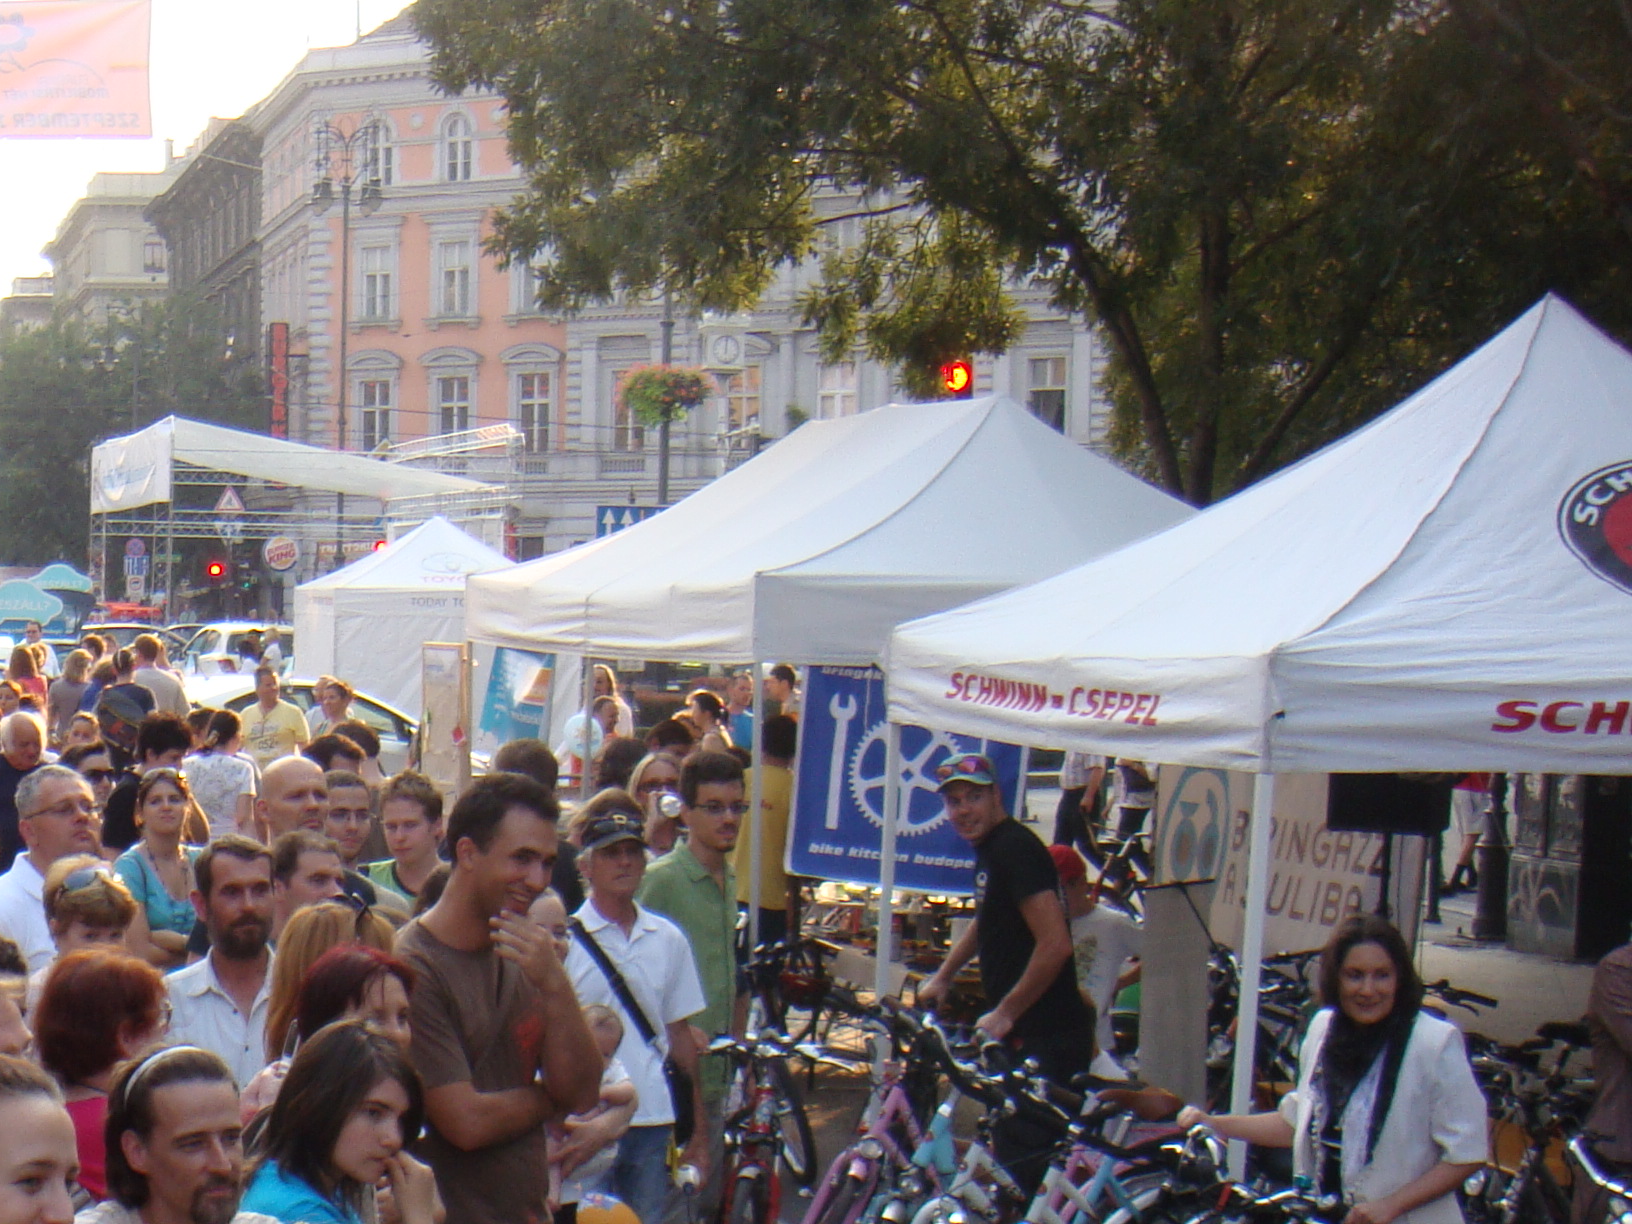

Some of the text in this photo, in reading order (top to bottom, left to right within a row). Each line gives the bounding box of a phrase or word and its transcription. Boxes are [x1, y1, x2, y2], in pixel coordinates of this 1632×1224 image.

[268, 549, 296, 565] KING
[945, 672, 1048, 712] SCHWINN
[1067, 686, 1160, 726] CSEPEL
[1490, 700, 1632, 735] SCH
[808, 842, 977, 870] bike kitcn budape
